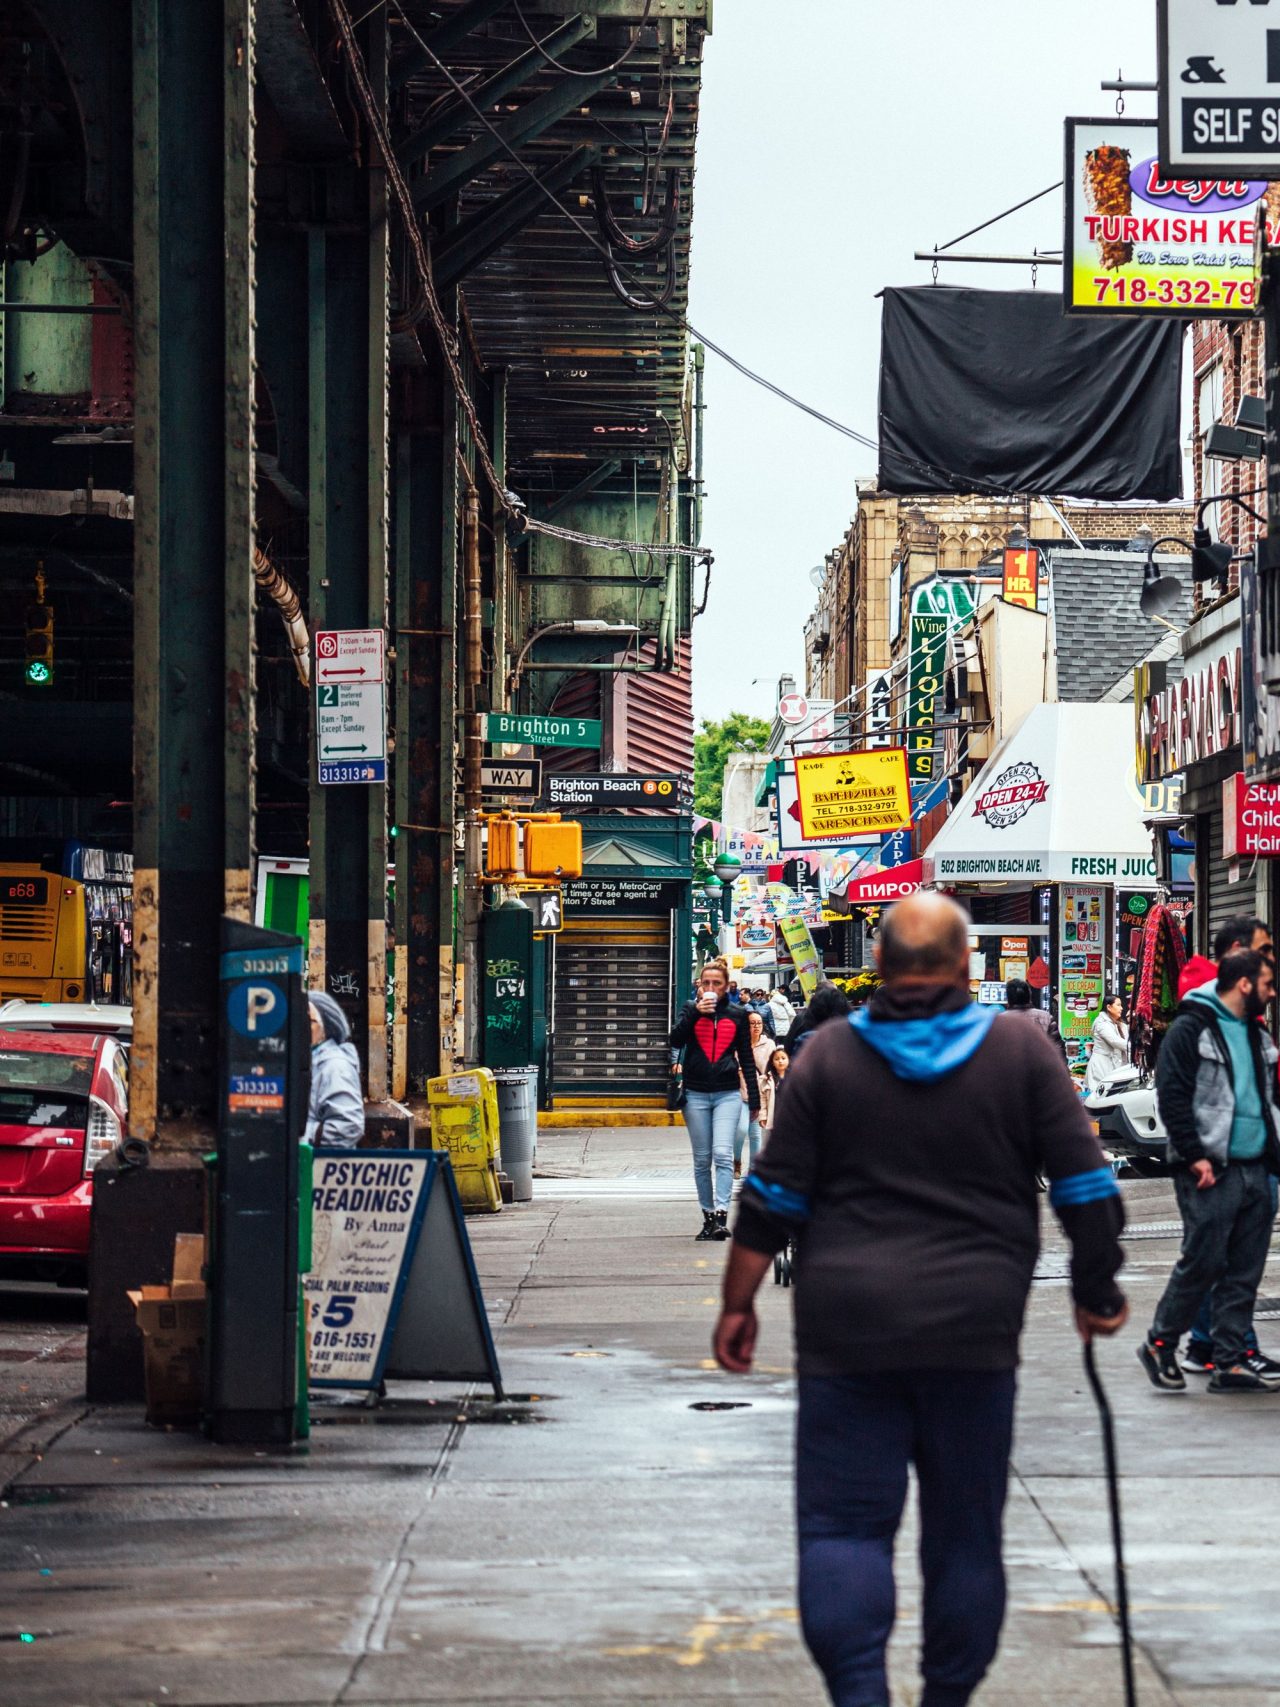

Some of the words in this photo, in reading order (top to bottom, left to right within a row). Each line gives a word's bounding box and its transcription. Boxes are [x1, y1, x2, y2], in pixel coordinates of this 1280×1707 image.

[1180, 56, 1227, 83] &
[1193, 107, 1253, 143] SELF
[1084, 216, 1208, 244] TURKISH
[1137, 251, 1155, 265] We
[1159, 254, 1188, 266] Serve
[1192, 254, 1225, 266] Halal
[1014, 554, 1028, 576] 1
[1007, 577, 1033, 591] HR.
[914, 619, 946, 634] Wine
[323, 685, 333, 705] 2
[340, 715, 353, 723] 7pm
[1149, 647, 1242, 780] PHARMACY
[321, 725, 342, 733] Except
[343, 725, 365, 733] Sunday
[500, 717, 570, 736] Brighton
[577, 722, 586, 737] 5
[530, 734, 556, 743] Street
[322, 767, 360, 781] 313313
[491, 770, 525, 785] WAY
[998, 767, 1019, 786] OPEN
[549, 780, 600, 792] Brighton
[603, 780, 641, 791] Beach
[647, 783, 654, 791] B
[661, 783, 669, 791] Q
[549, 791, 593, 803] Station
[982, 789, 1014, 808] OPEN
[1014, 783, 1043, 801] 24-7
[816, 807, 835, 815] TEL.
[839, 802, 896, 812] 718-332-9797
[988, 811, 1007, 825] OPEN
[940, 861, 955, 873] 502
[956, 860, 996, 873] BRIGHTON
[997, 859, 1024, 873] BEACH
[1025, 859, 1043, 873] AVE.
[1072, 857, 1117, 876] FRESH
[9, 883, 35, 897] B68
[602, 882, 616, 890] buy
[619, 882, 662, 891] MetroCard
[624, 891, 647, 899] agent
[1121, 912, 1143, 926] OPEN
[1003, 939, 1027, 950] Open
[243, 958, 289, 973] 313313
[1067, 981, 1075, 991] ICE
[1077, 981, 1096, 991] CREAM
[981, 987, 1006, 1001] EBT
[247, 987, 276, 1031] P
[1072, 1017, 1091, 1027] COFFEE
[236, 1081, 278, 1094] 313313
[322, 1162, 413, 1187] PSYCHIC
[312, 1188, 413, 1213] READINGS
[344, 1218, 362, 1236] By
[366, 1218, 406, 1233] Anna
[355, 1240, 389, 1250] Past
[340, 1253, 396, 1263] Present
[339, 1267, 388, 1276] Future
[326, 1280, 351, 1292] PALM
[352, 1280, 390, 1293] READING
[313, 1331, 376, 1348] 616-1551
[315, 1350, 331, 1361] ARE
[333, 1351, 371, 1362] WELCOME
